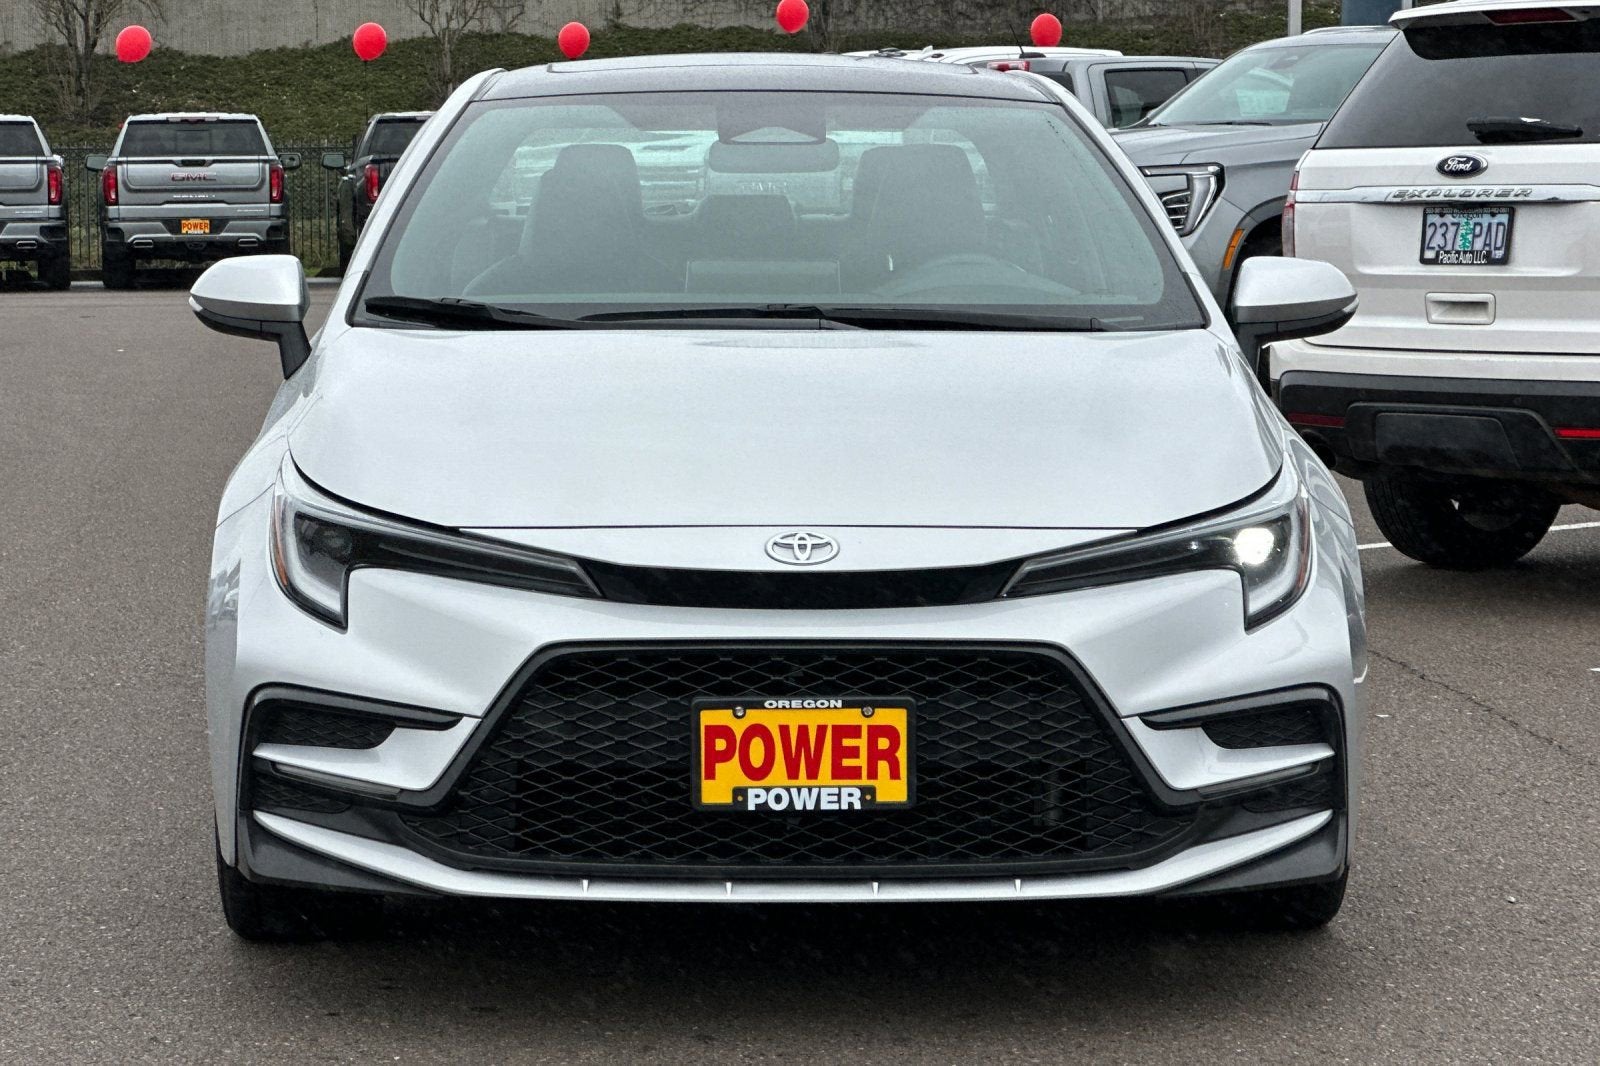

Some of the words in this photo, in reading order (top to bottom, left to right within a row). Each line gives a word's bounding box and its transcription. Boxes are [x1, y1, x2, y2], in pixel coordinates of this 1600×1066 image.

[1444, 157, 1472, 171] Ford
[171, 172, 217, 182] GMC
[1393, 189, 1533, 199] EXPLORER
[182, 222, 209, 231] POWER
[1426, 222, 1461, 250] 237
[1471, 222, 1506, 250] PAD
[1438, 250, 1458, 264] Pacific
[1459, 251, 1473, 263] Auto
[763, 699, 843, 709] OREGON
[703, 723, 902, 782] POWER
[747, 787, 862, 811] POWER
